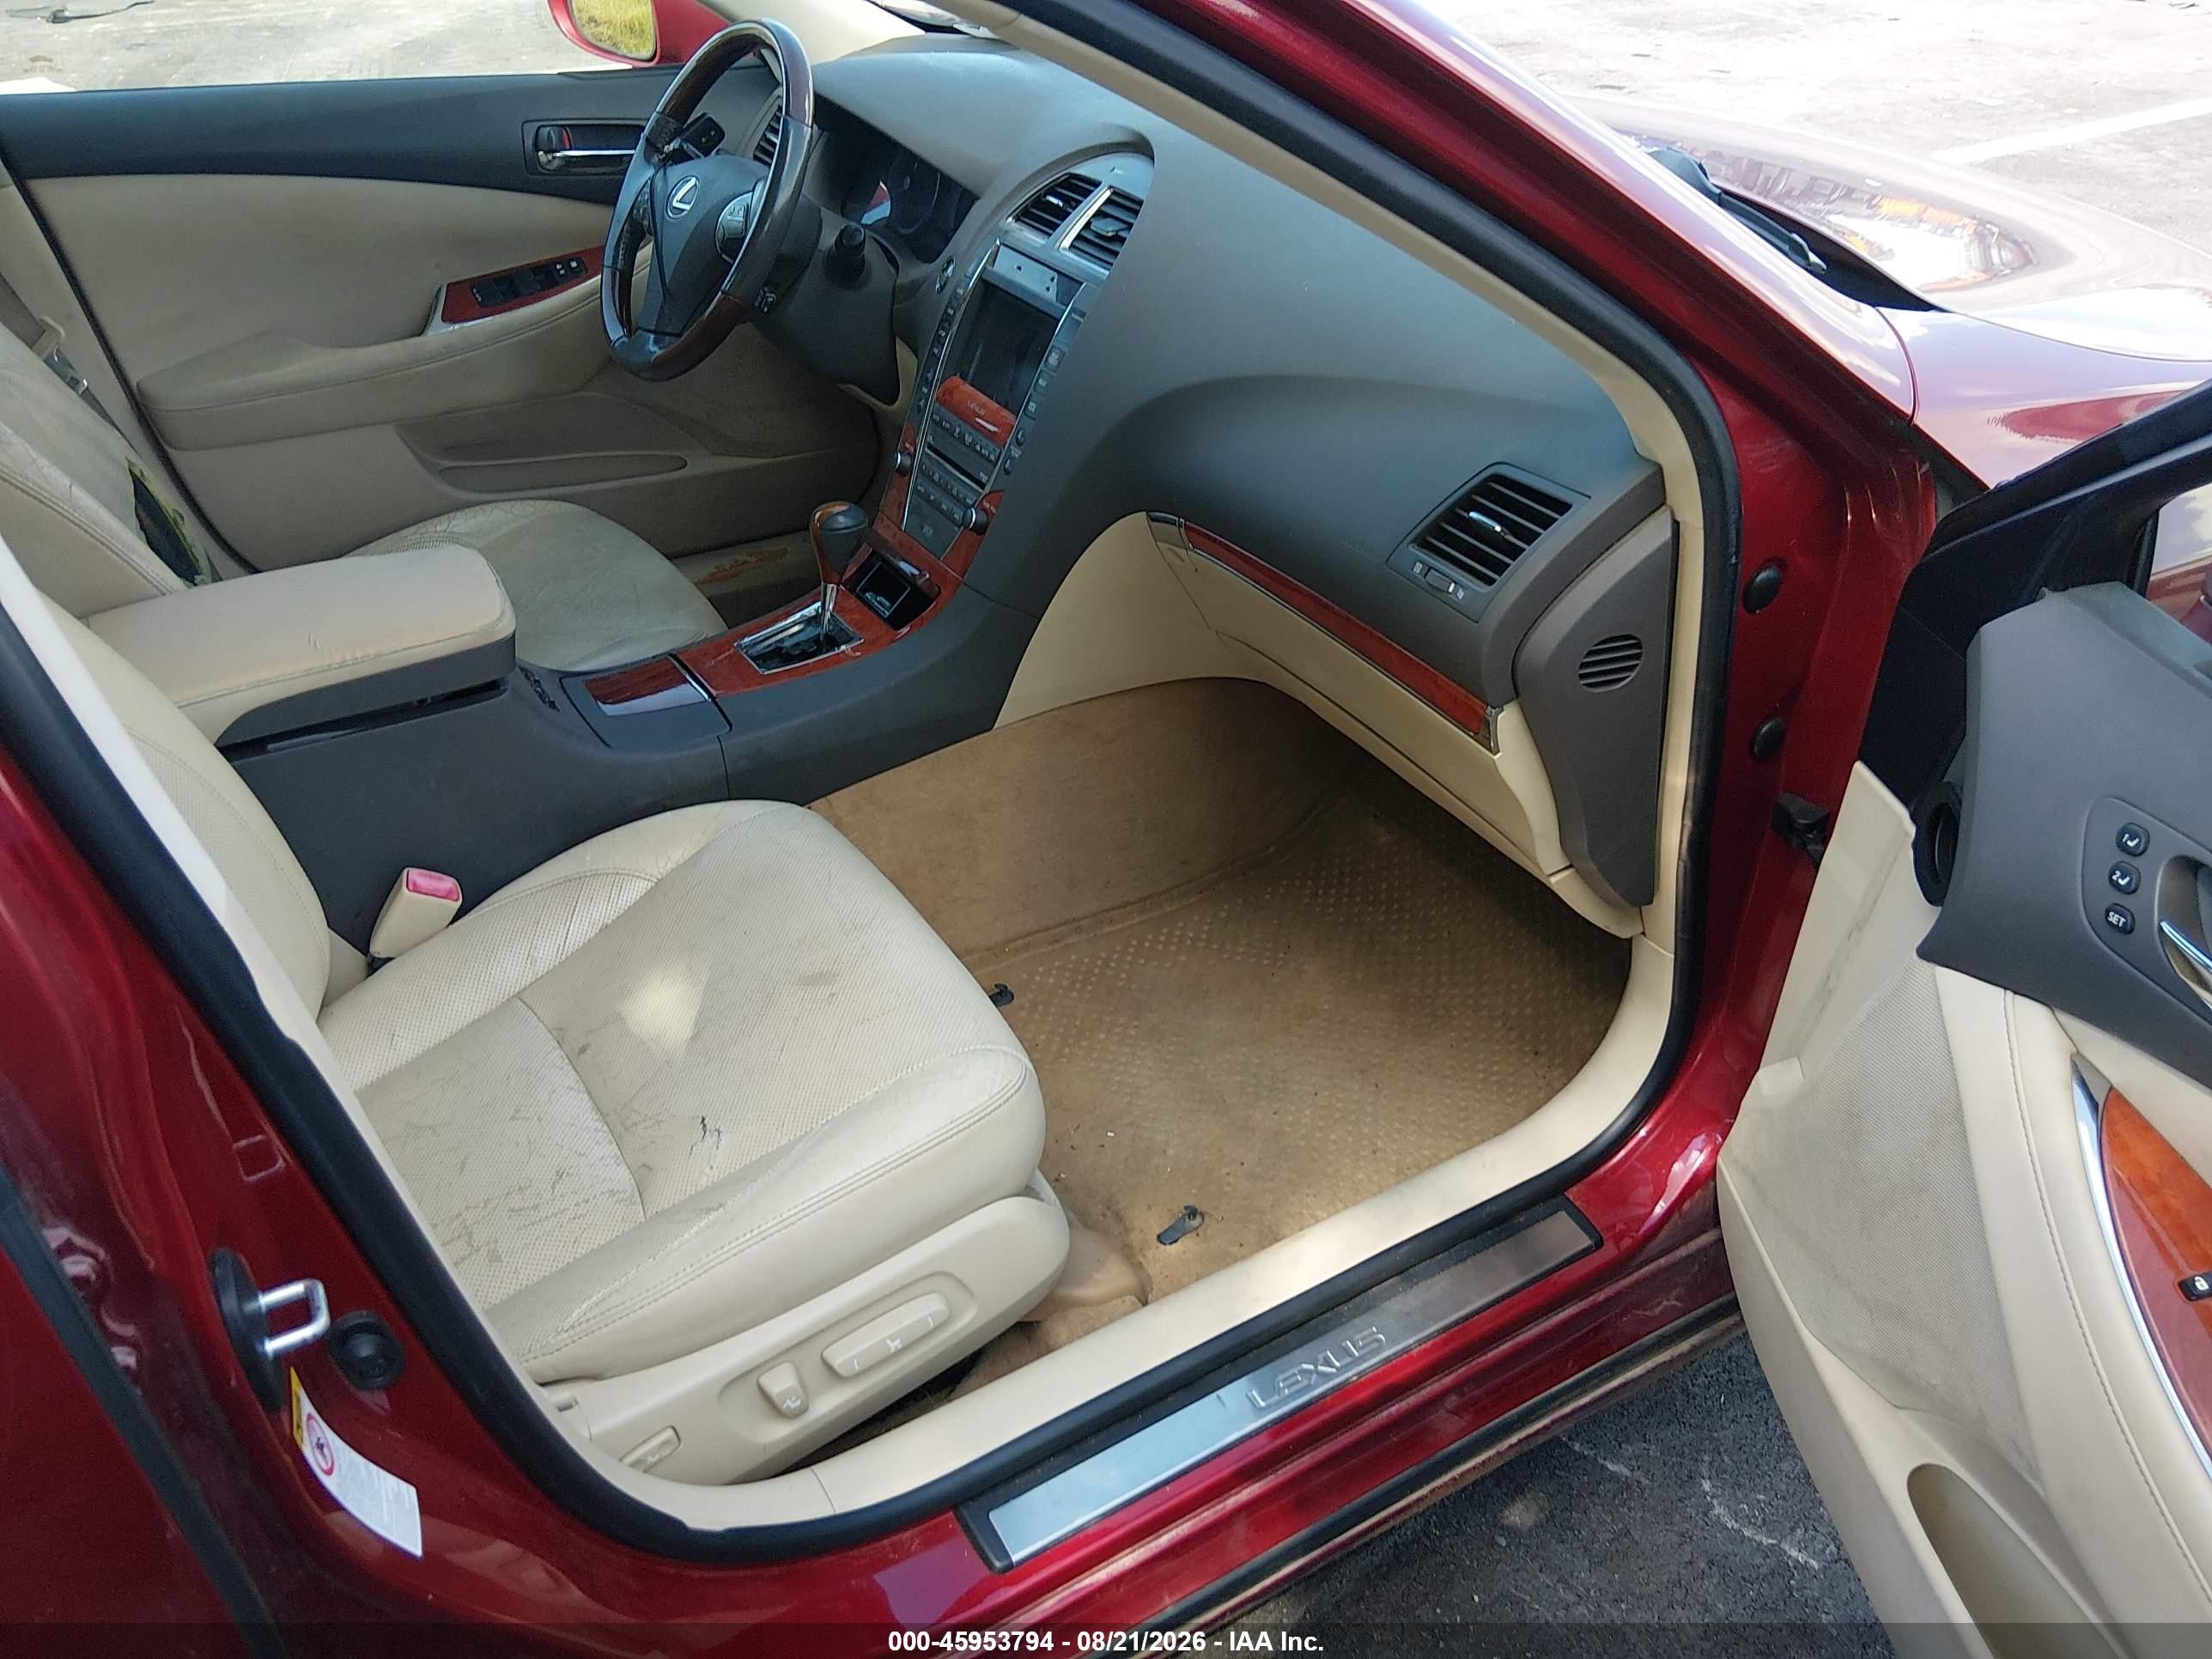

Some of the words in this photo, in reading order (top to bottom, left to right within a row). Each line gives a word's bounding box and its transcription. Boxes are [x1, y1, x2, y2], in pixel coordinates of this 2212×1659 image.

[2112, 870, 2121, 881] 2
[2107, 911, 2126, 927] SET
[1247, 1327, 1386, 1409] LEXUS
